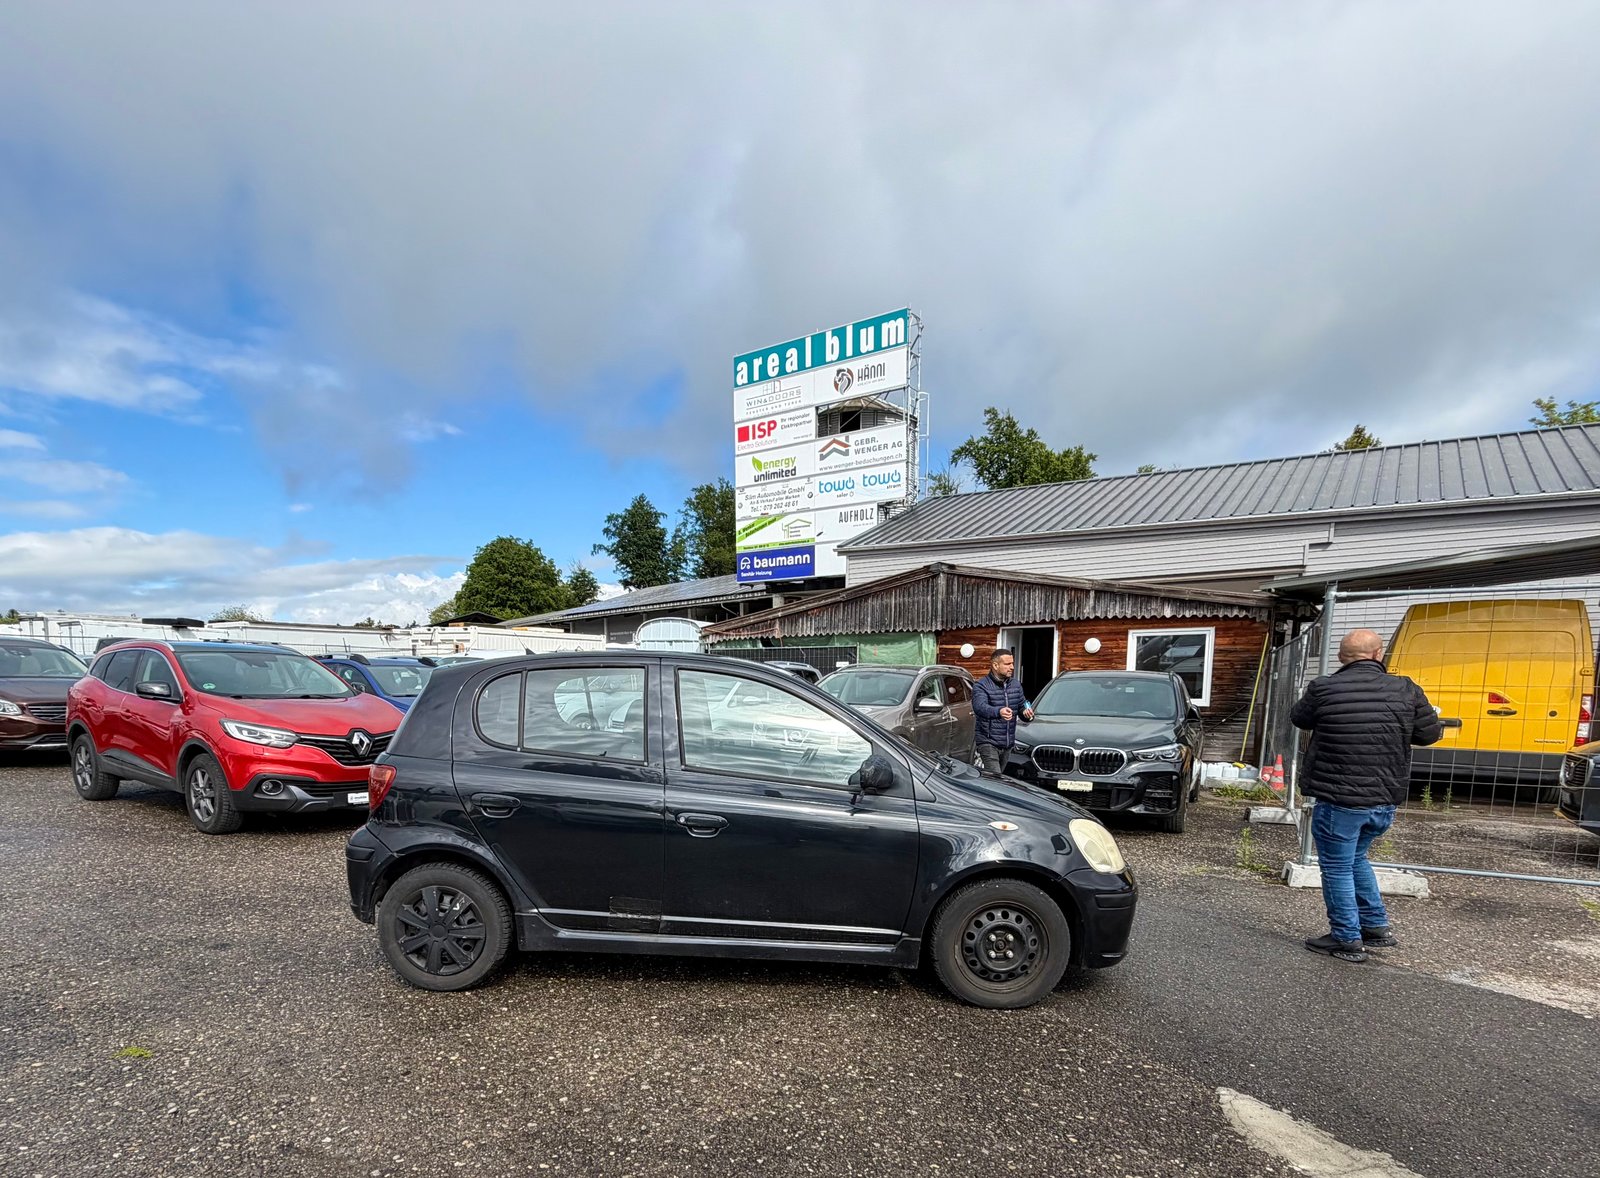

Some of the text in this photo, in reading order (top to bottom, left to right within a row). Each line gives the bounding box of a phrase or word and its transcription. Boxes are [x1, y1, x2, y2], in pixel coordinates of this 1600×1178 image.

[825, 317, 904, 363] blum
[752, 420, 778, 440] ISP
[854, 436, 879, 446] GEBR.
[854, 440, 902, 455] WENGER AG
[763, 456, 797, 470] energy
[754, 466, 797, 482] unlimited
[756, 490, 787, 499] Automobile
[788, 486, 806, 494] GmbH
[838, 508, 874, 524] AUFHOLZ
[754, 554, 810, 568] baumann
